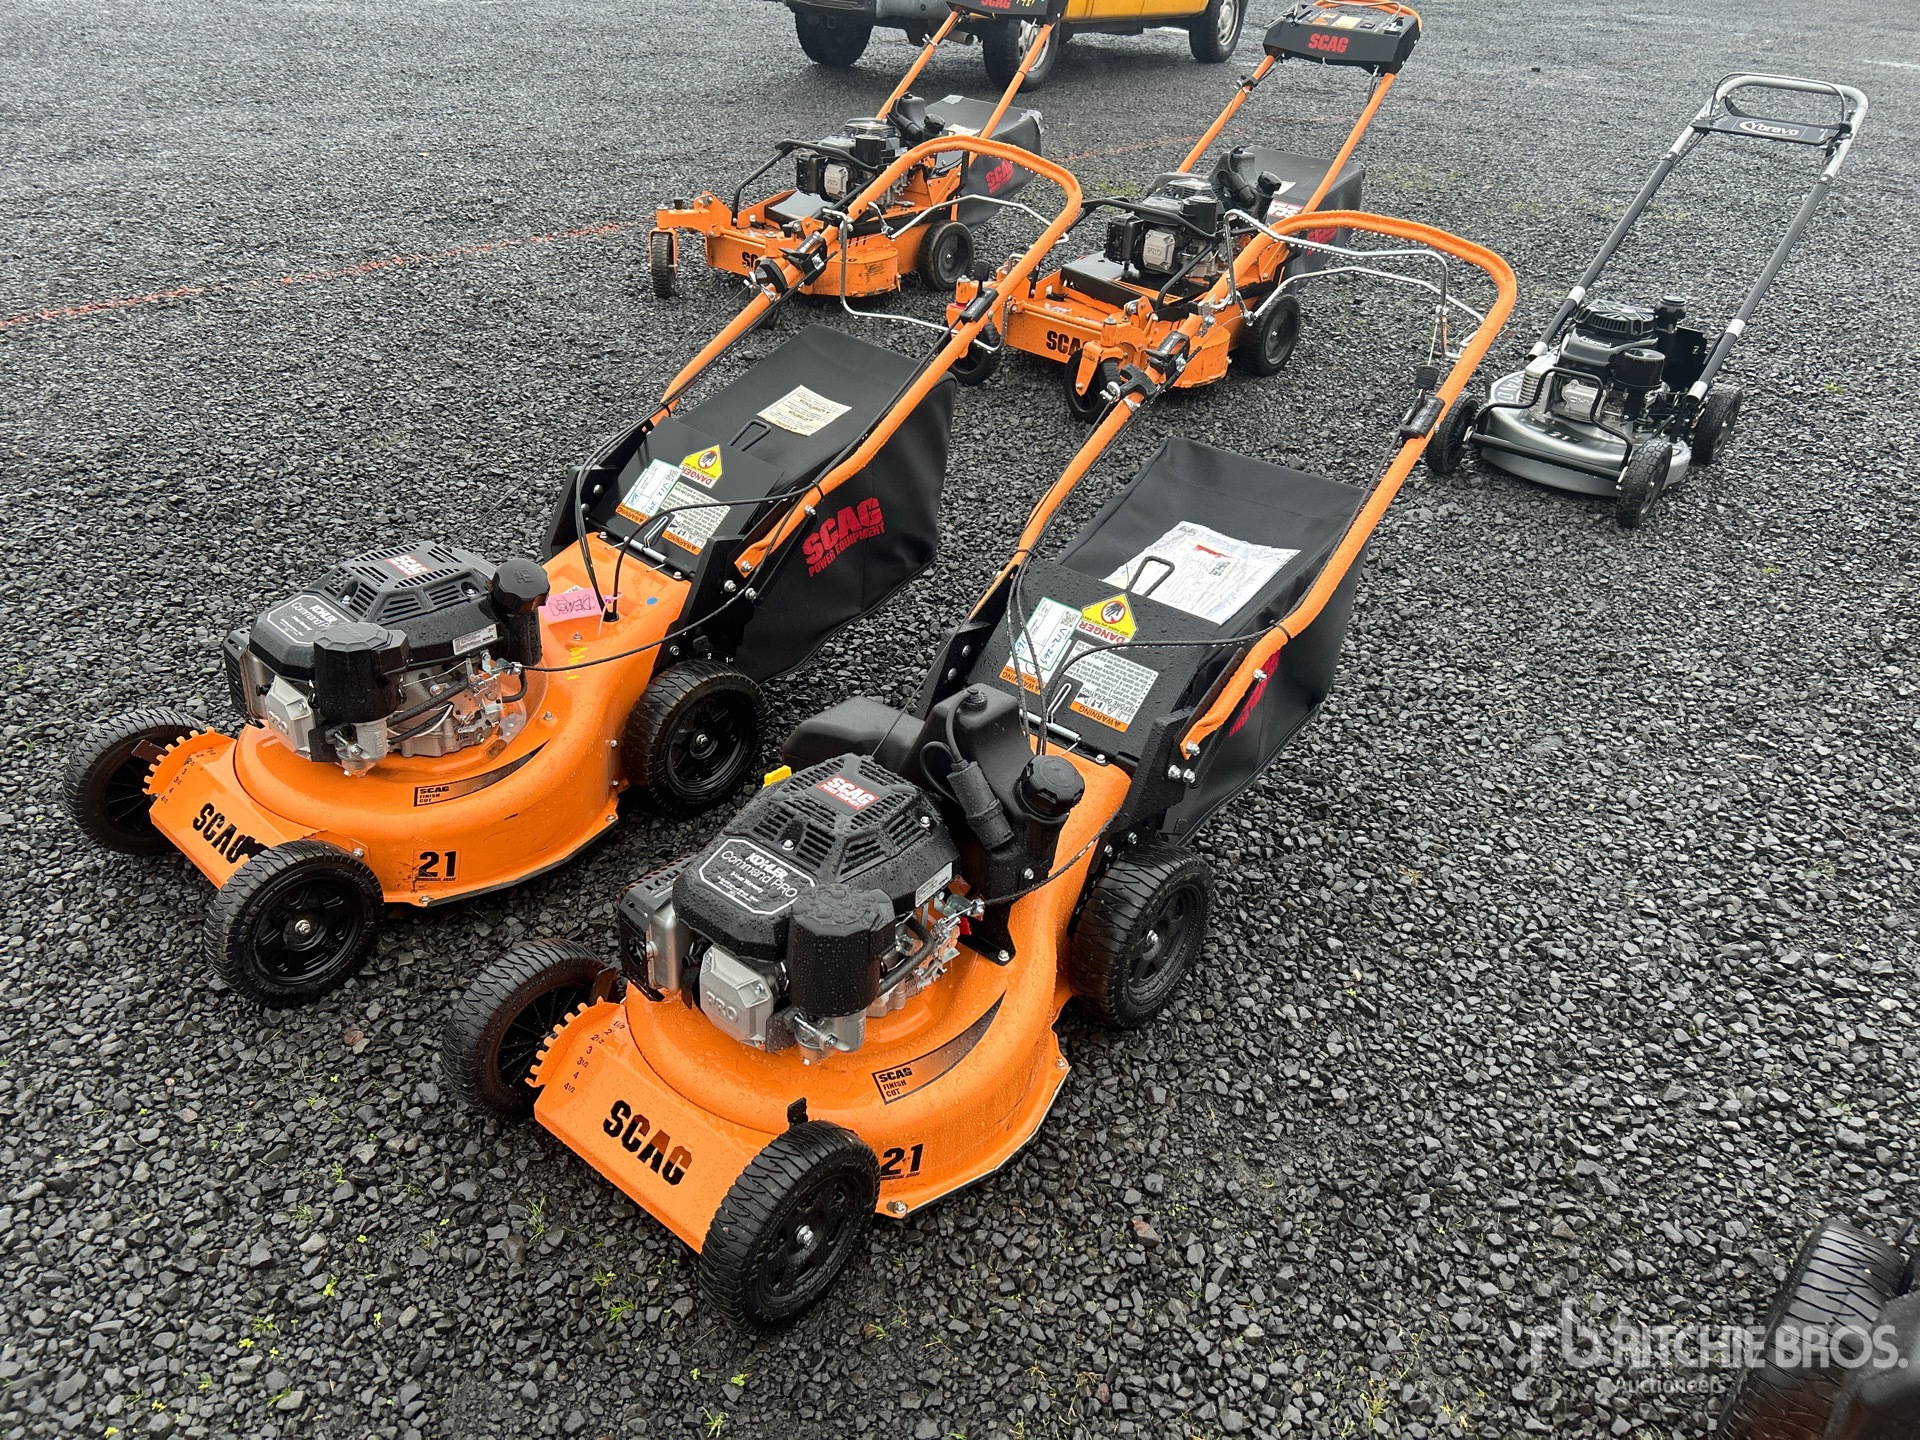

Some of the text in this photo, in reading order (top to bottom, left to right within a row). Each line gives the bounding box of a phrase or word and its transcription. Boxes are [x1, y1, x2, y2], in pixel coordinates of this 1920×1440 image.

[1308, 34, 1349, 52] SCAG
[1746, 121, 1799, 136] Ybravo
[1046, 330, 1090, 355] SCA
[680, 466, 712, 485] DANGER
[667, 533, 691, 549] WARNING
[802, 497, 884, 567] SCAG
[808, 522, 886, 578] POWER EQUIPMENT
[290, 599, 323, 626] Command
[1078, 620, 1125, 644] DANGER
[1081, 686, 1135, 714] BEFORE OPERATING
[1078, 704, 1114, 725] WARNING
[420, 786, 450, 794] SCAG
[826, 775, 875, 806] SCAG
[418, 850, 456, 878] 21
[720, 848, 773, 885] Command
[769, 876, 798, 900] PRO
[706, 990, 738, 1022] PRO
[586, 1046, 592, 1054] 3
[573, 1071, 580, 1080] 4
[878, 1067, 913, 1083] SCAG
[882, 1080, 907, 1090] FINISH
[886, 1087, 901, 1097] CUT
[602, 1099, 694, 1186] SCAG
[880, 1143, 924, 1176] 21
